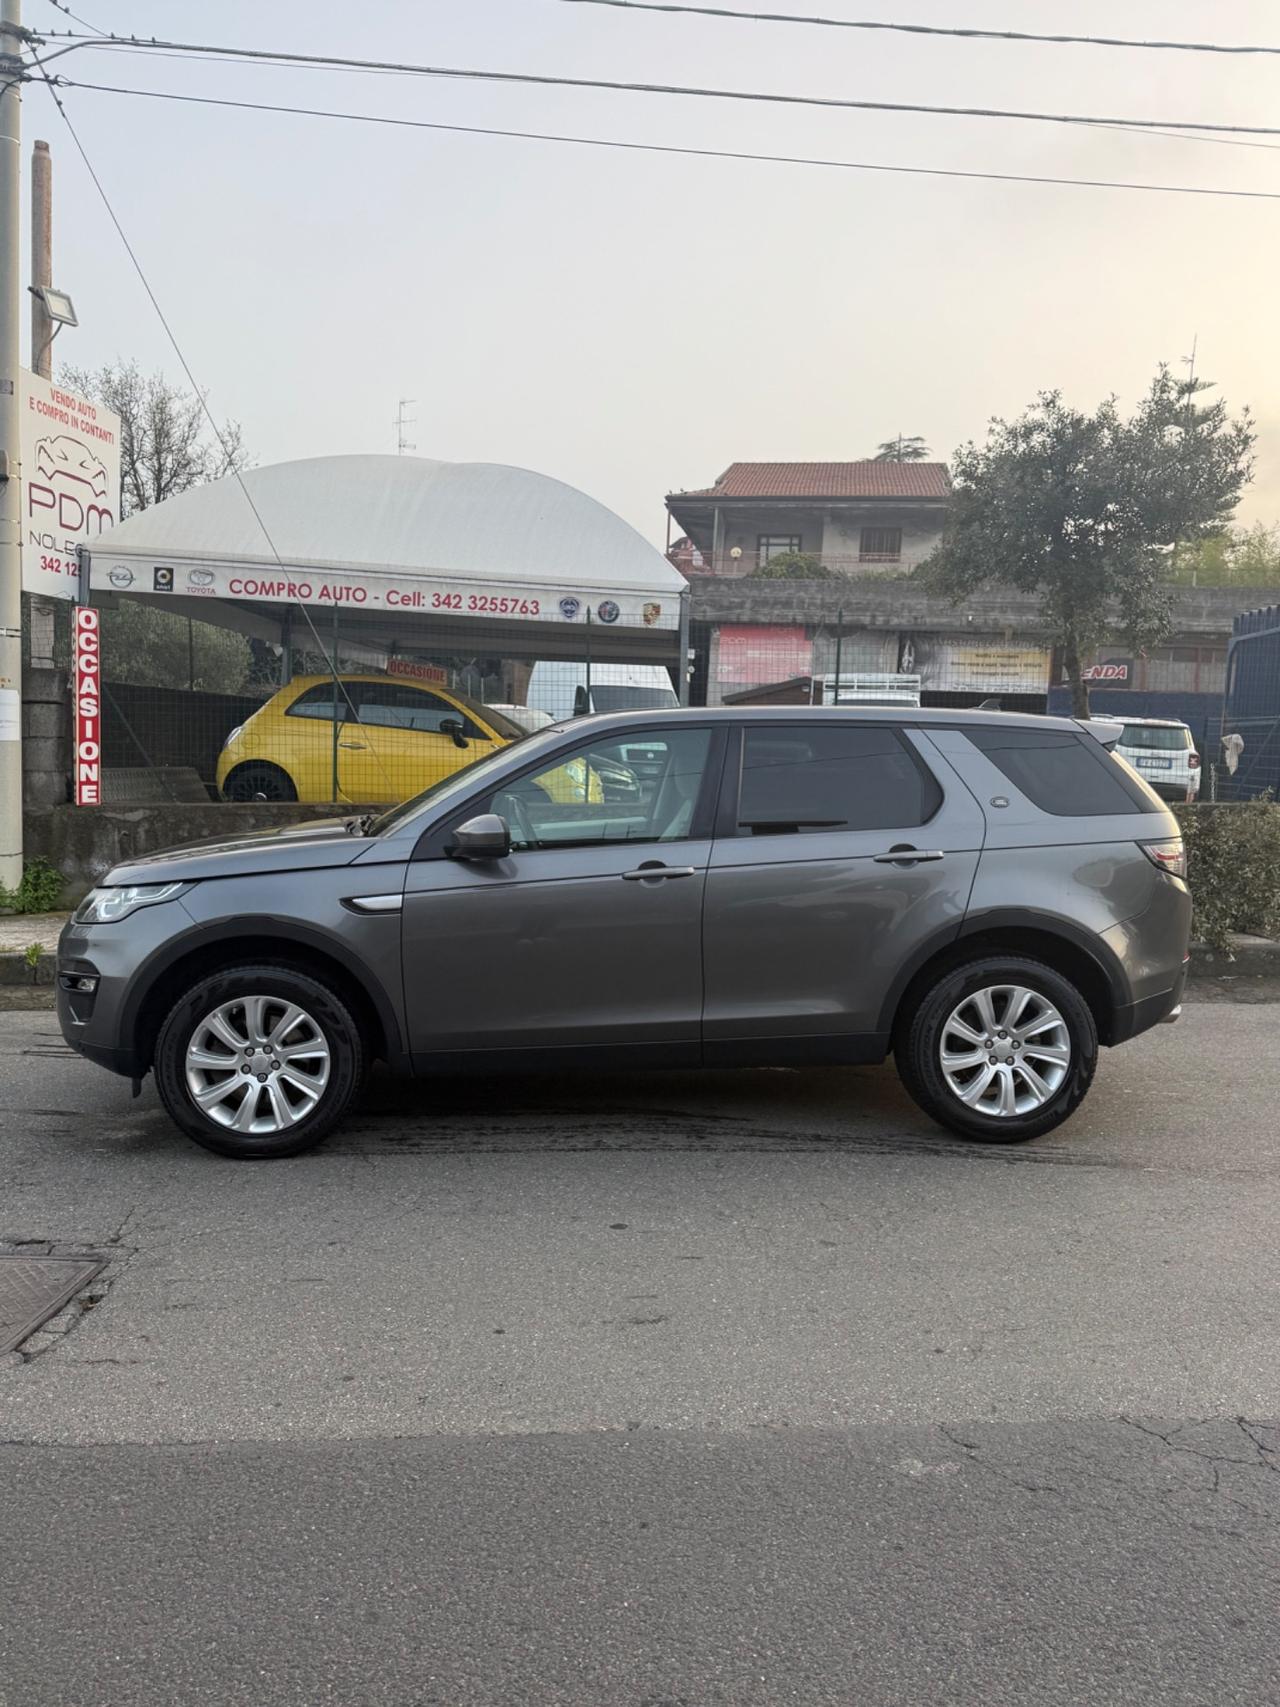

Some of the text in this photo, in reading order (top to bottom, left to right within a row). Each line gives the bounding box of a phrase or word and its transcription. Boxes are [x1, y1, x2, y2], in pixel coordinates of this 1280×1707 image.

[50, 387, 97, 420] VENDO AUTO
[29, 396, 114, 445] E COMPRO IN CONTANTI
[40, 555, 62, 574] 342
[186, 586, 217, 595] TOYOTA
[229, 578, 313, 599] COMPRO
[318, 584, 367, 603] AUTO
[386, 589, 426, 607] Cell:
[431, 592, 463, 609] 342
[467, 595, 540, 616] 3255763
[389, 660, 445, 682] OCCASIONE
[78, 609, 99, 804] OCCASIONE
